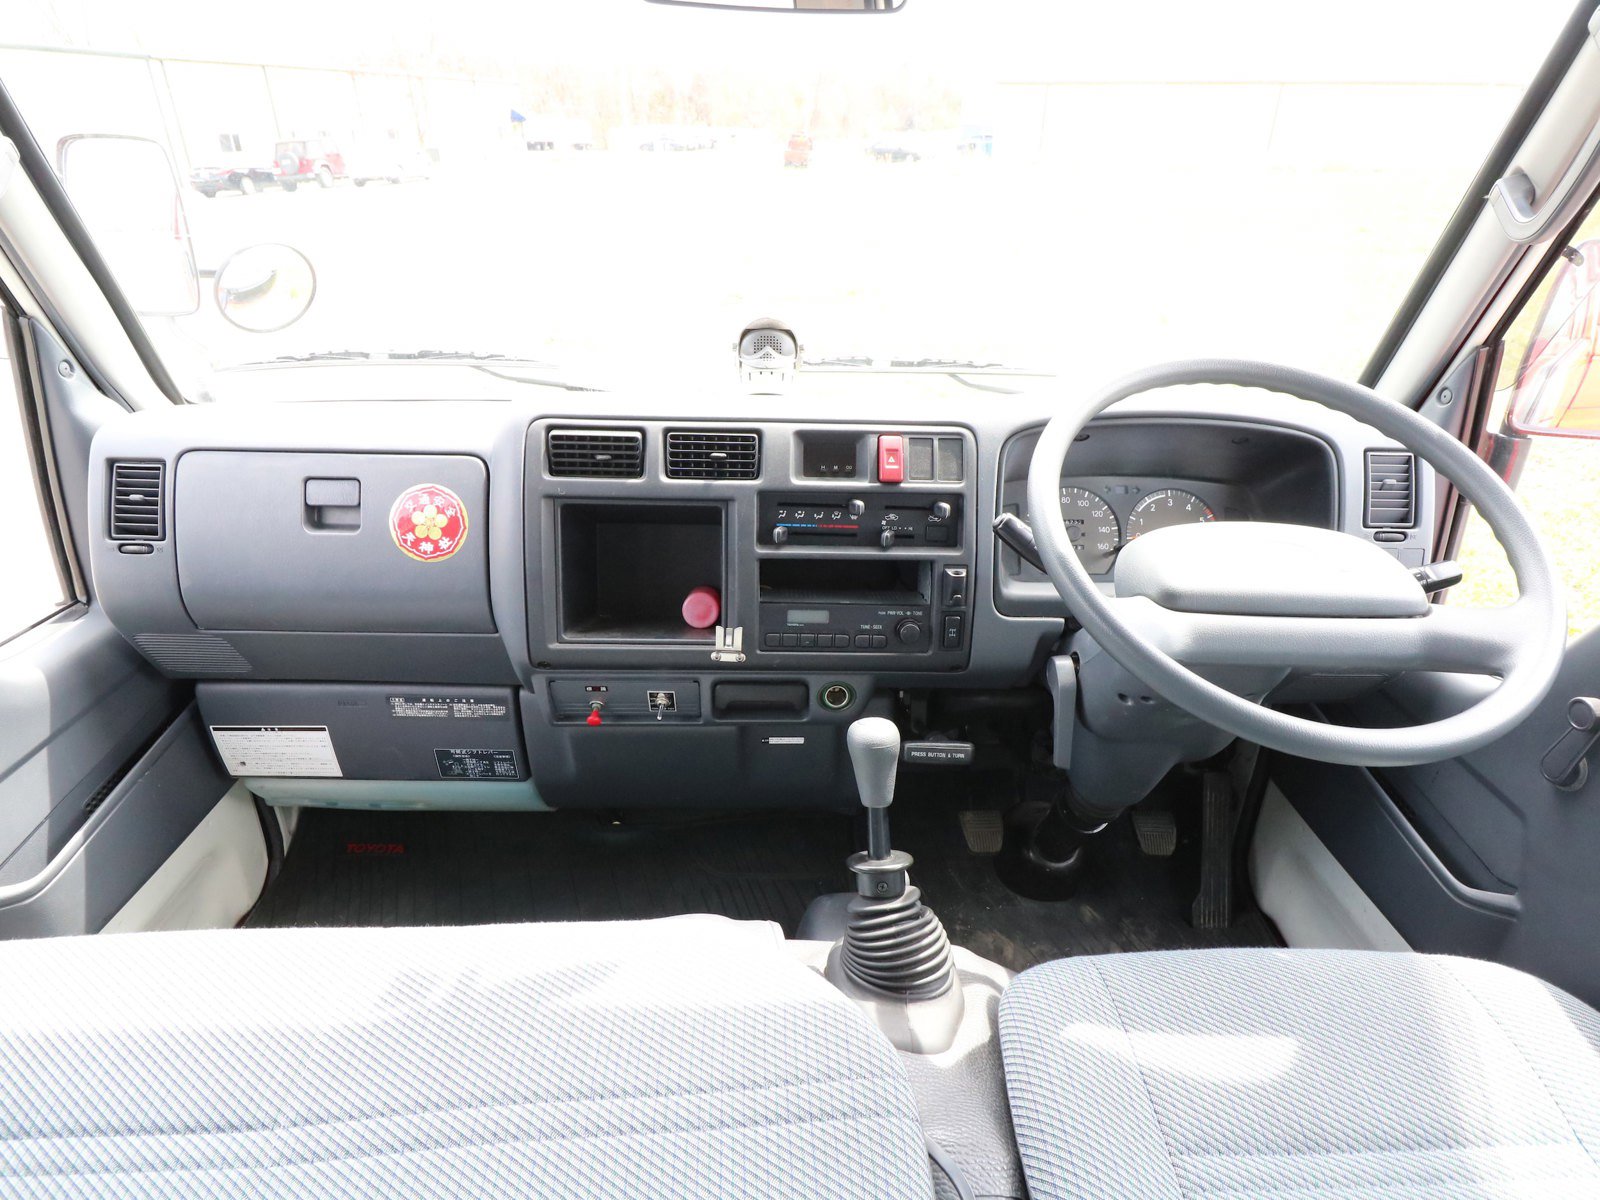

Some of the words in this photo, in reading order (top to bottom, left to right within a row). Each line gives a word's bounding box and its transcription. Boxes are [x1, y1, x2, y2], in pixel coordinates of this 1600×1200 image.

[1061, 496, 1071, 504] 80
[1167, 498, 1173, 507] 3
[1150, 503, 1156, 512] 2
[1185, 503, 1192, 511] 4
[1091, 510, 1104, 518] 120
[1139, 518, 1144, 526] 1
[1098, 526, 1111, 534] 140
[346, 842, 404, 855] TOYOTA
